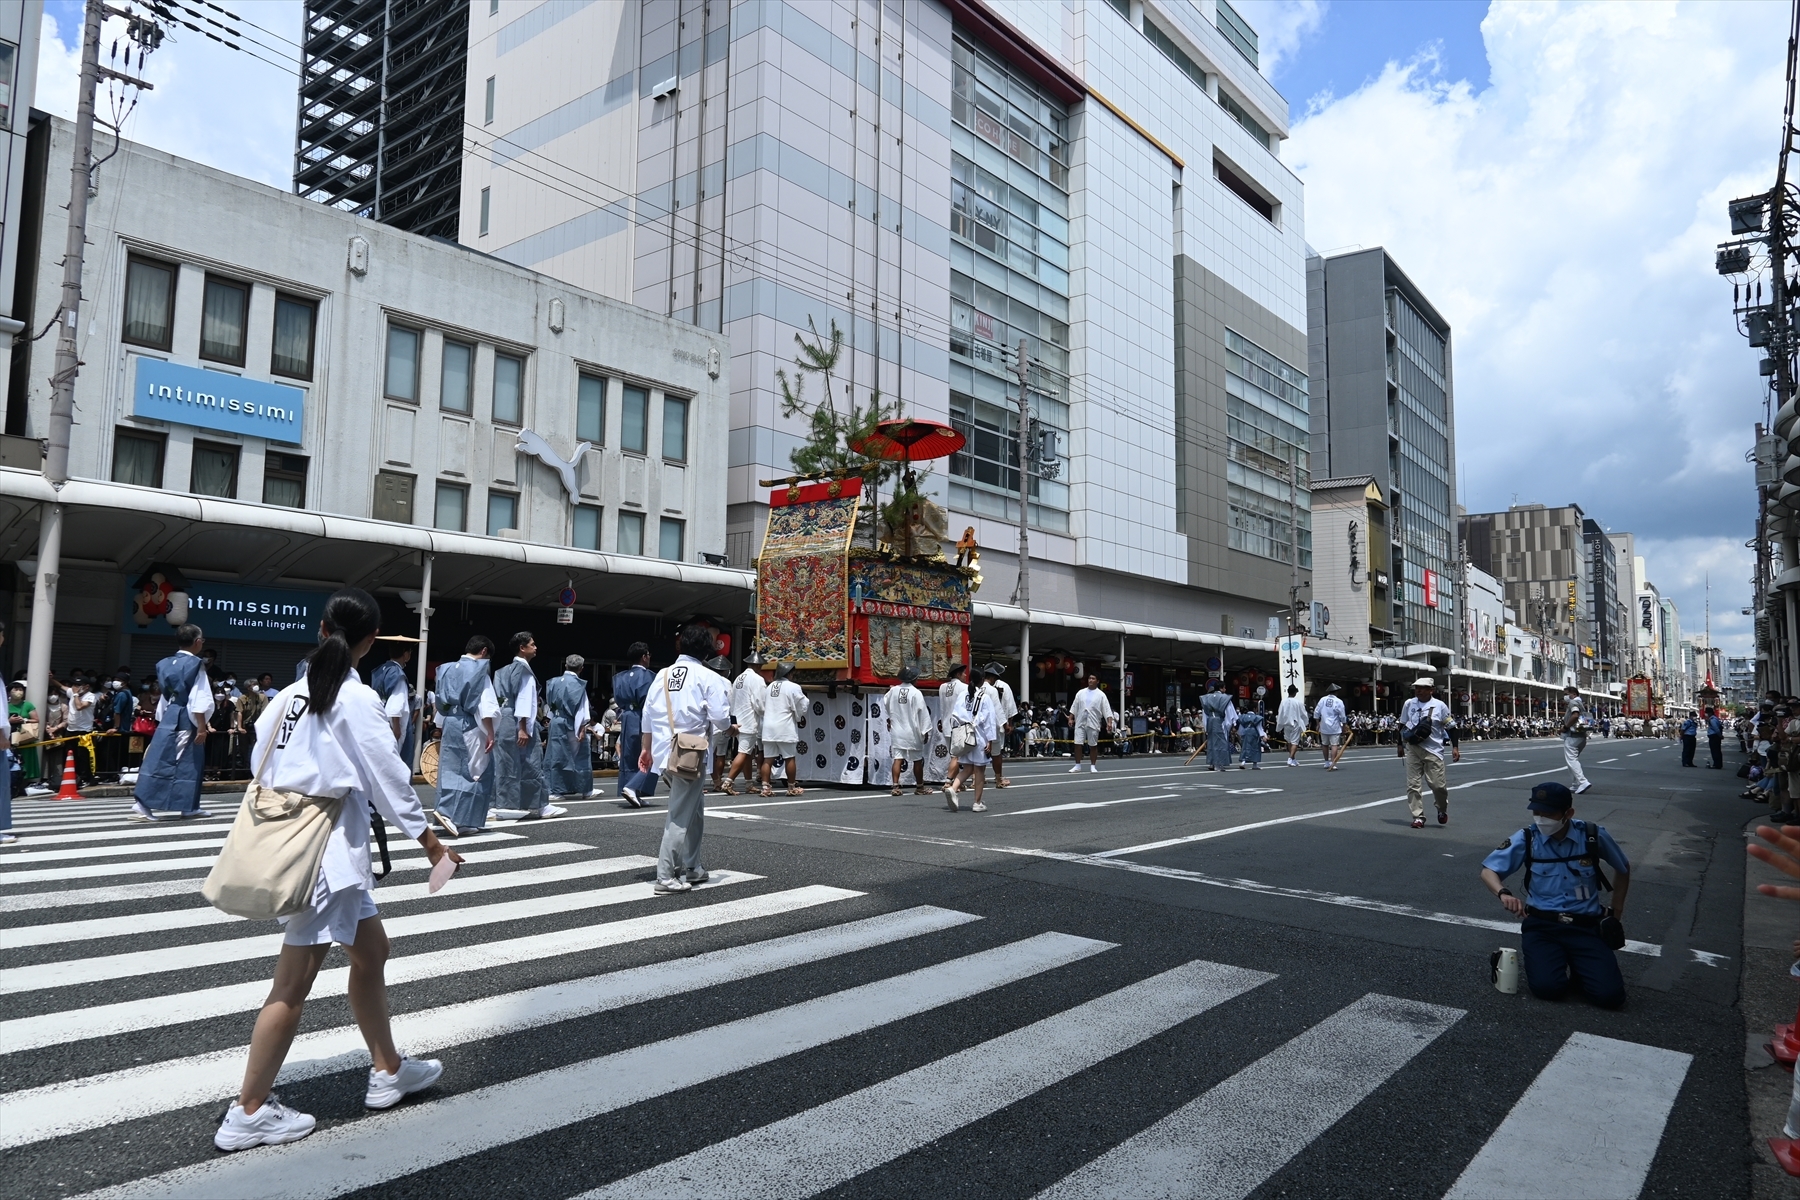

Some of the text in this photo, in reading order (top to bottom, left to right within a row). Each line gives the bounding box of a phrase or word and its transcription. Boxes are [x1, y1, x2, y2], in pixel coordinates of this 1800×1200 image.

[975, 344, 993, 363] 古着屋
[149, 383, 293, 422] intimissimi
[229, 616, 306, 631] Italian lingerie
